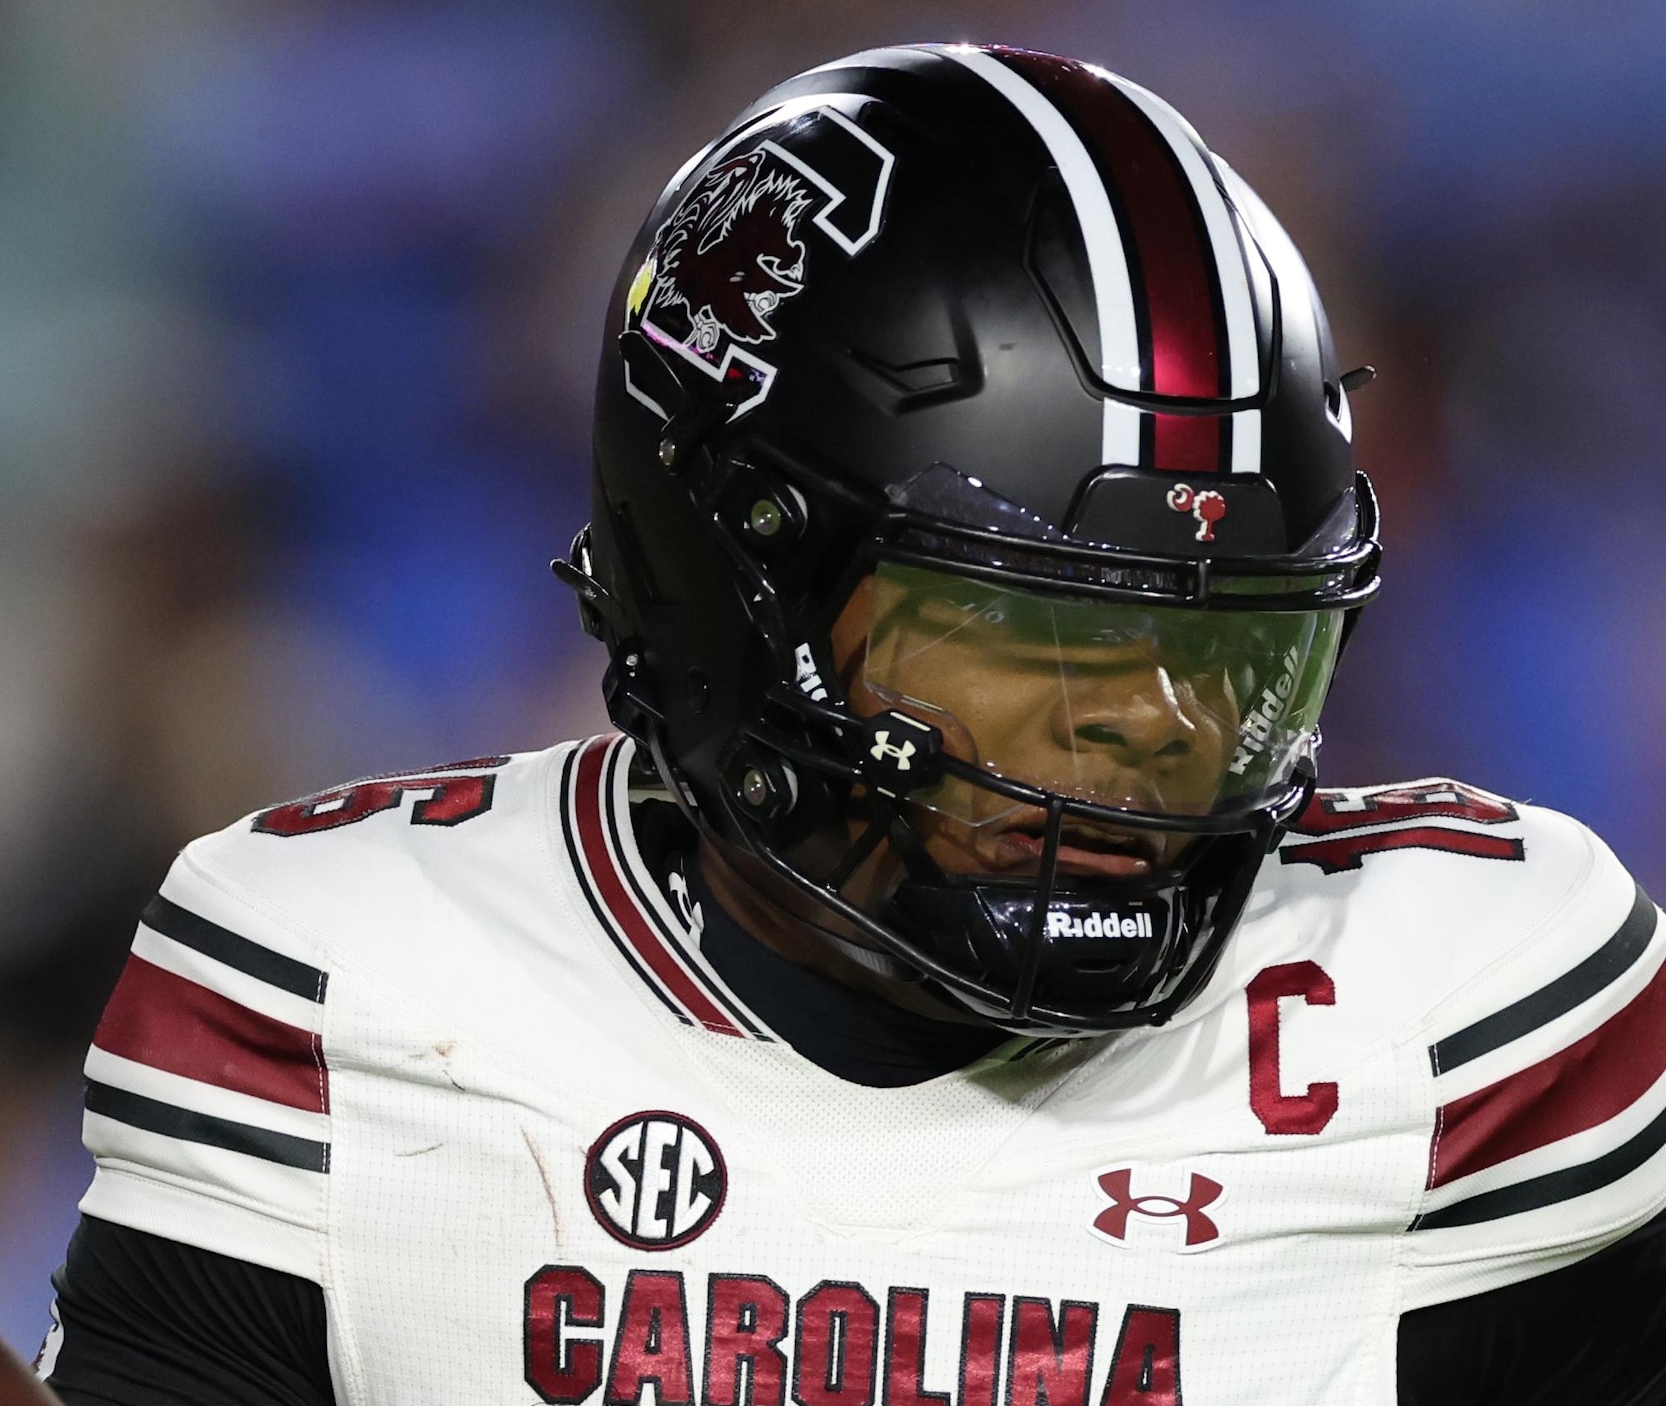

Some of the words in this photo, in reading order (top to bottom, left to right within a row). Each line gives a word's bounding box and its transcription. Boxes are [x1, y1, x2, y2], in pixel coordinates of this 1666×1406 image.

[1228, 645, 1298, 776] Riddell
[1046, 911, 1153, 938] Riddell
[1246, 960, 1337, 1136] C
[596, 1116, 716, 1240] SEC
